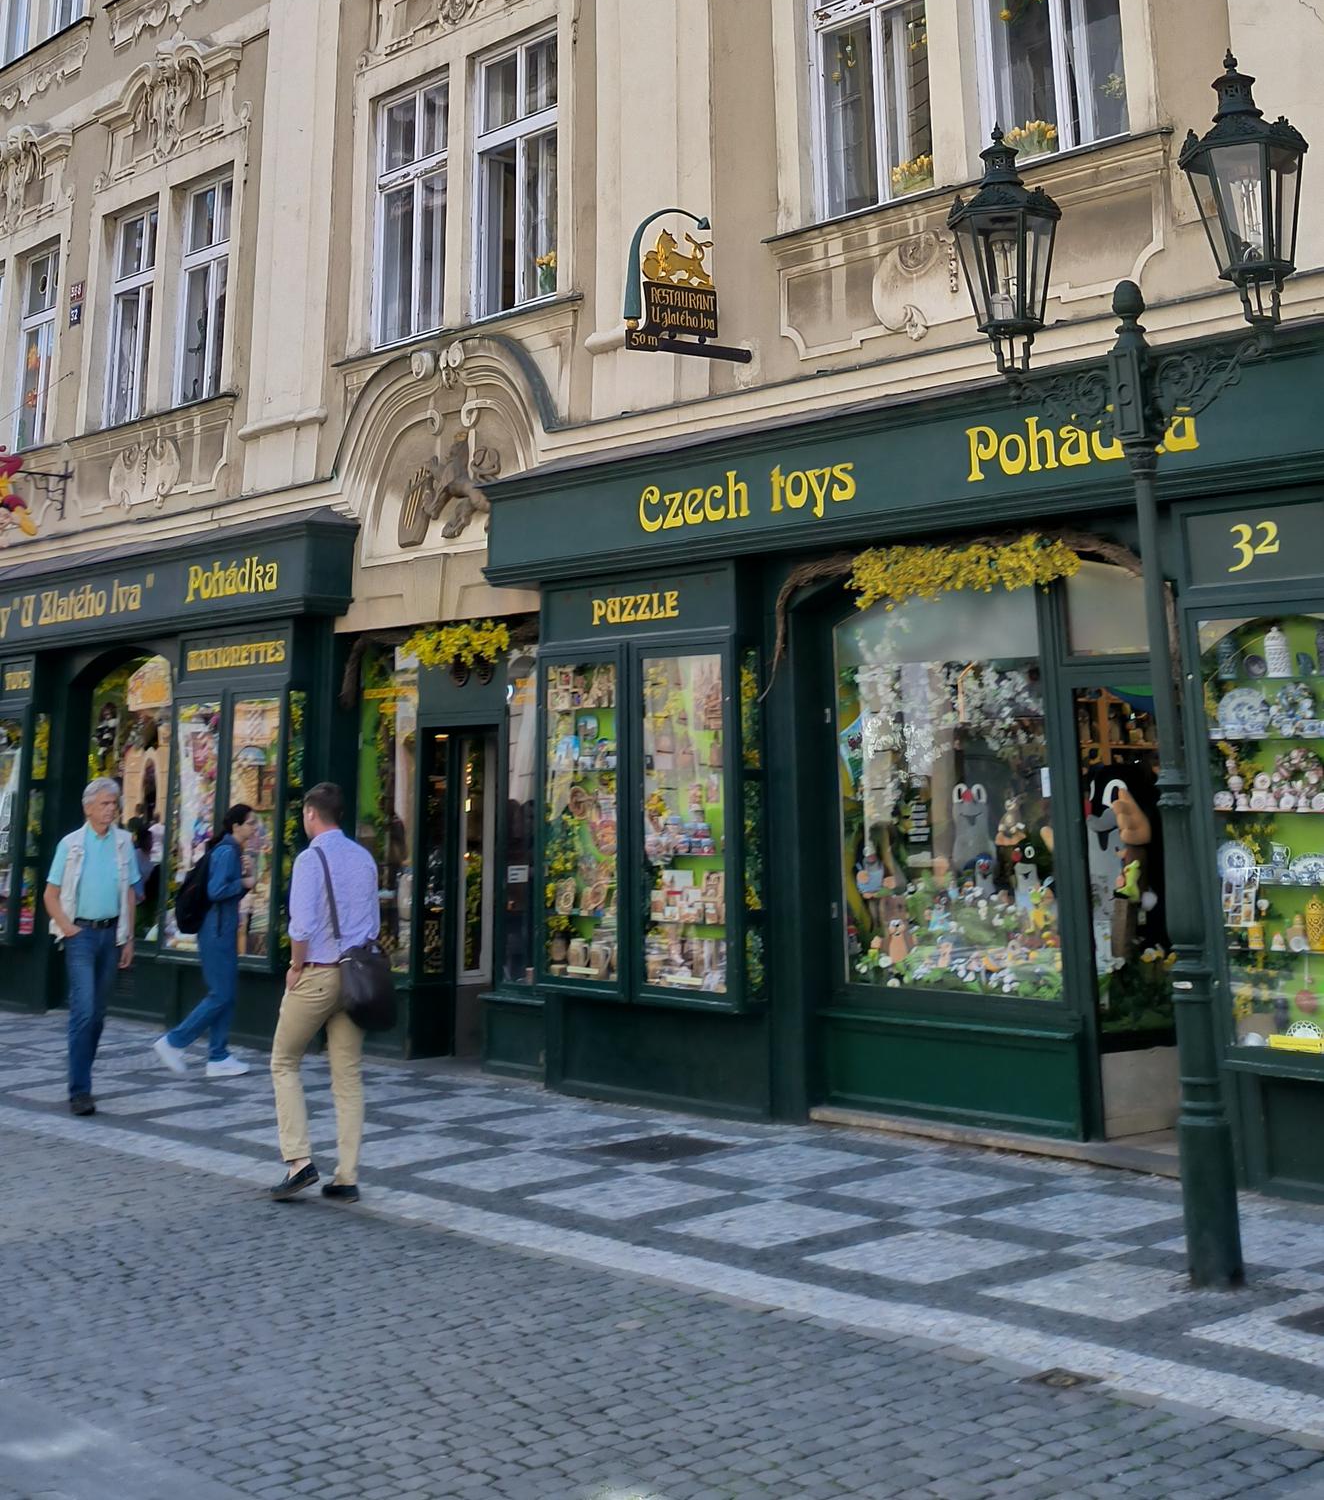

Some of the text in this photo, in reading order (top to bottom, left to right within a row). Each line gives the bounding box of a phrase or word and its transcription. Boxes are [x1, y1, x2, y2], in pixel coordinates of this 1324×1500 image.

[651, 286, 715, 312] RESTAURANT
[651, 306, 715, 330] U zlatého lva
[630, 332, 659, 347] 50 m
[638, 462, 857, 533] Czech toys
[1227, 520, 1281, 573] 32
[184, 555, 280, 603] Pohádka
[37, 583, 107, 626] Zlatého
[591, 589, 680, 626] PUZZLE
[186, 639, 286, 672] MARIONETTES
